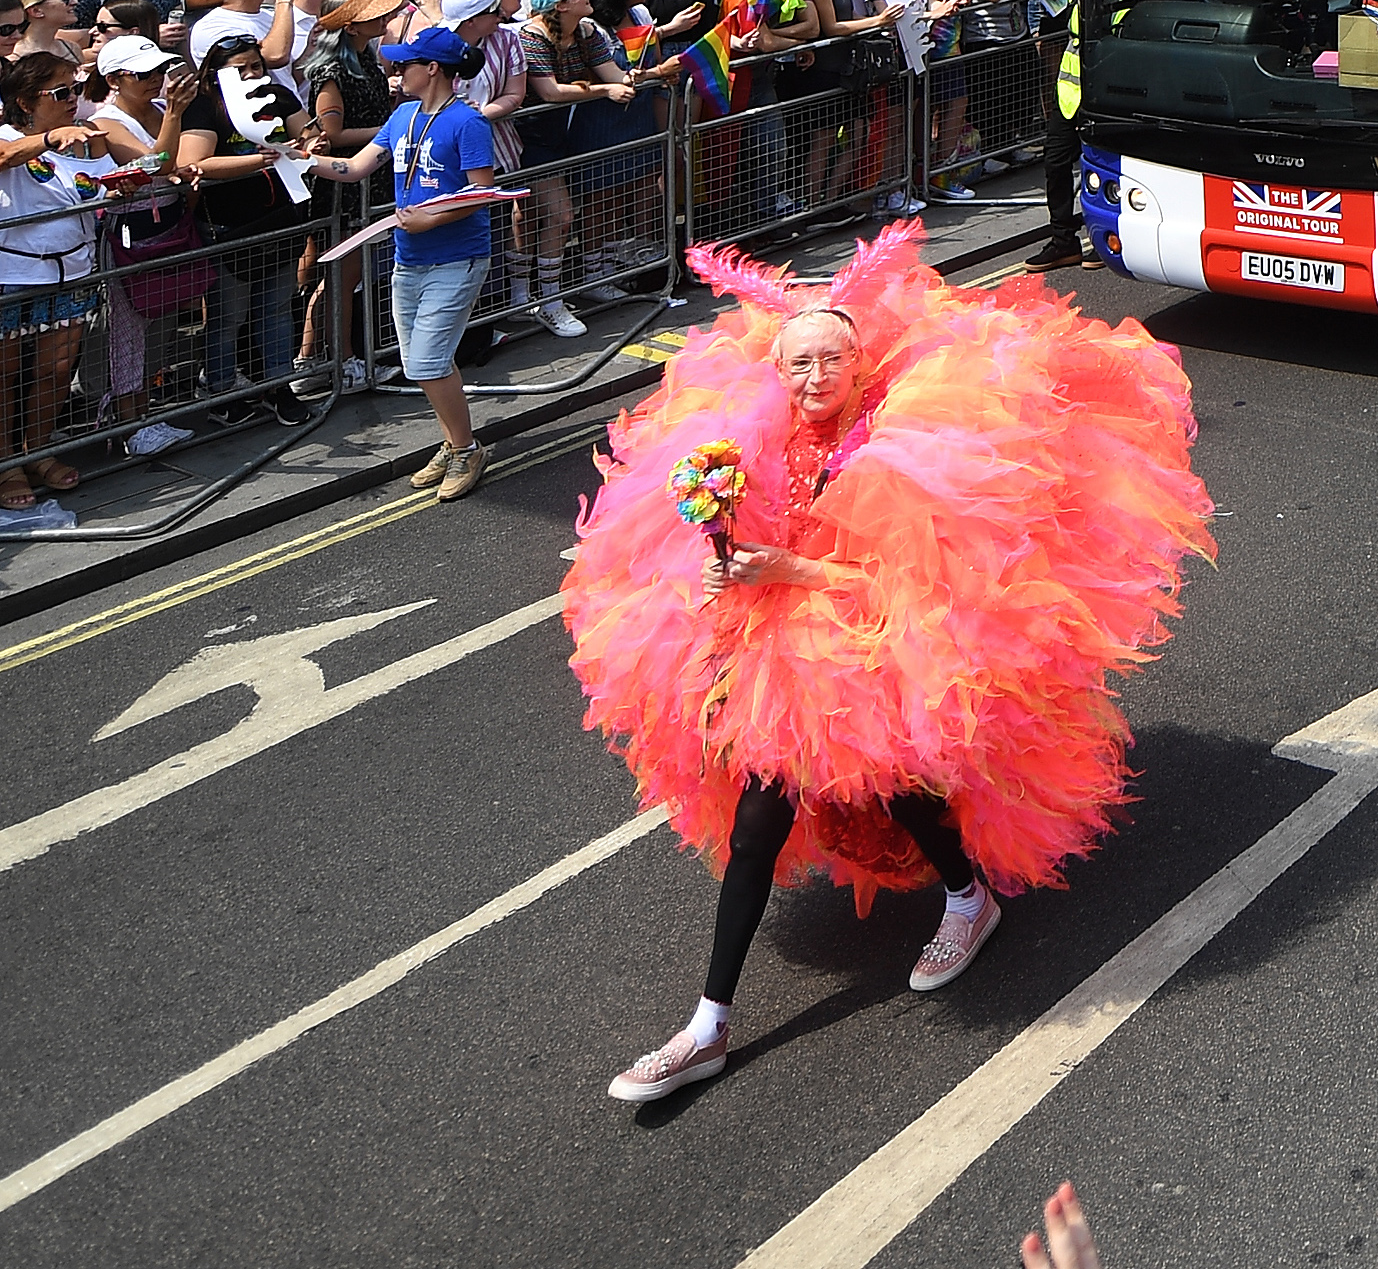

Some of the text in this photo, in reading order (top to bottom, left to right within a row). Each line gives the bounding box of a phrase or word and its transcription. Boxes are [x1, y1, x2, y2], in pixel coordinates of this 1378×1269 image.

[1254, 153, 1305, 168] VOLVO
[1271, 190, 1299, 206] THE
[1237, 210, 1339, 234] ORIGINAL TOUR
[1248, 255, 1335, 286] EU05 DVW
